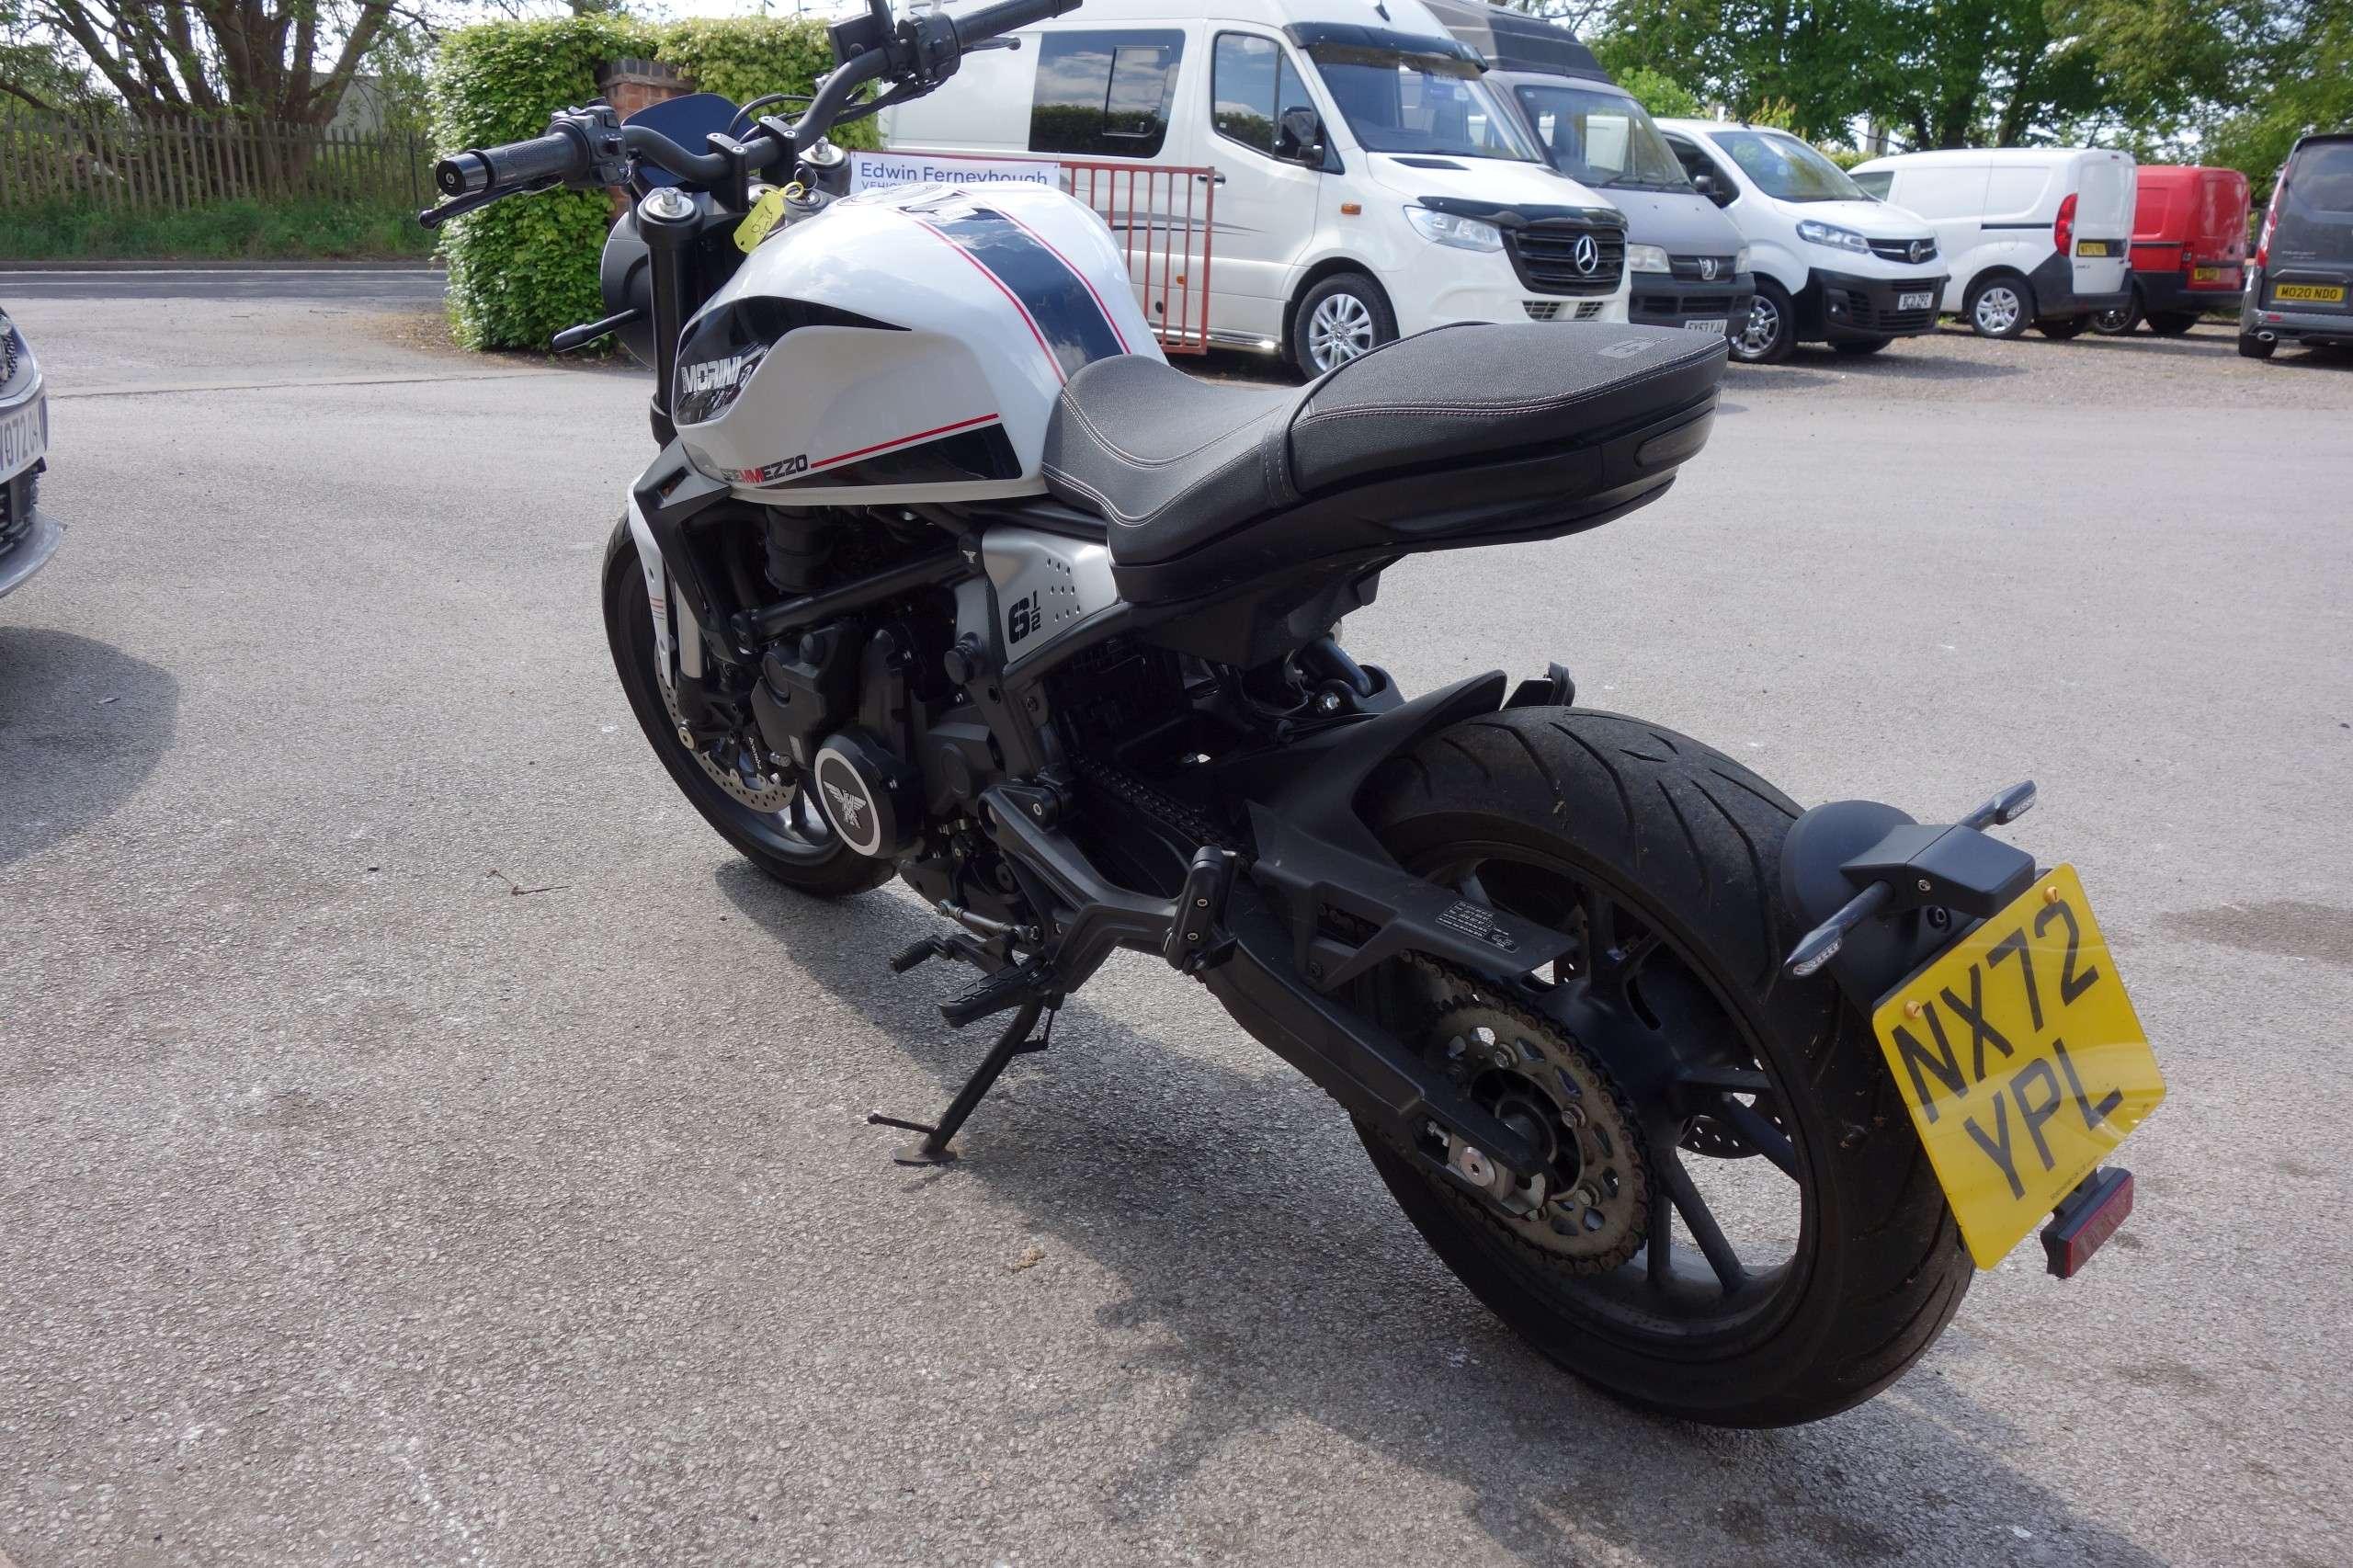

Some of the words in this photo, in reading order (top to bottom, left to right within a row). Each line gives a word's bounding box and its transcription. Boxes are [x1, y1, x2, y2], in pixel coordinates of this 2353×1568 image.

[861, 162, 917, 181] Edwin
[2280, 286, 2312, 298] MO20
[683, 356, 742, 393] MORINI
[1891, 898, 2099, 1125] NX72
[1962, 1037, 2124, 1201] YPL
